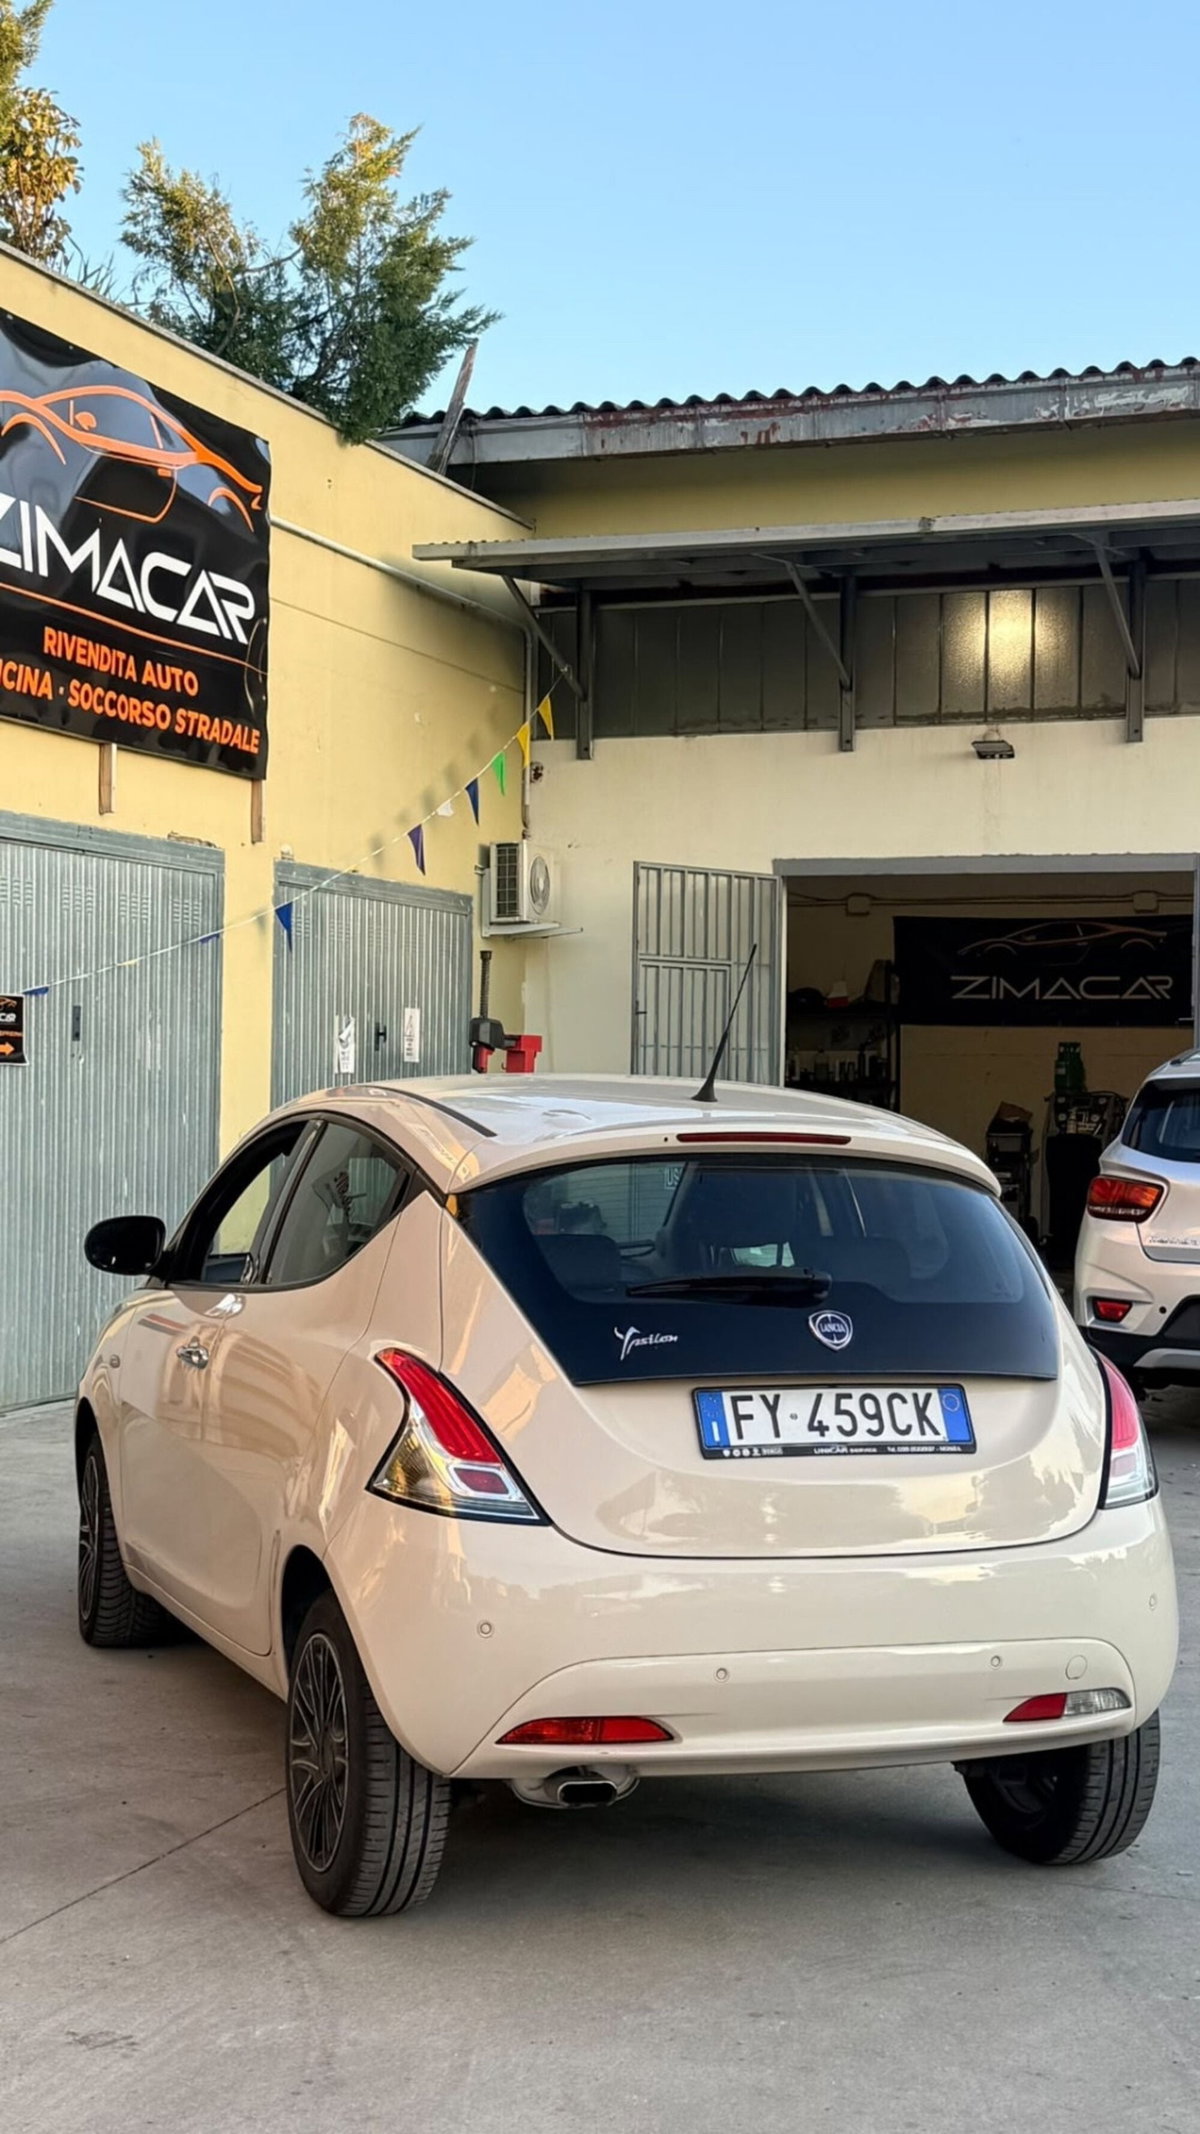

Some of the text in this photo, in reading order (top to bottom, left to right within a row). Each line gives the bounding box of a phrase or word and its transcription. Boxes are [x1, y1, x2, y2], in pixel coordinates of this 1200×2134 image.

[43, 626, 199, 697] RIVENDITA AUTO
[67, 678, 171, 731] SOCCORSO
[174, 707, 261, 755] STRADALE
[950, 976, 1173, 1000] ZIMACAR
[614, 1326, 678, 1361] Ypsilon
[820, 1323, 846, 1333] LANCIA
[731, 1394, 780, 1440] FY
[808, 1392, 940, 1437] 459CK
